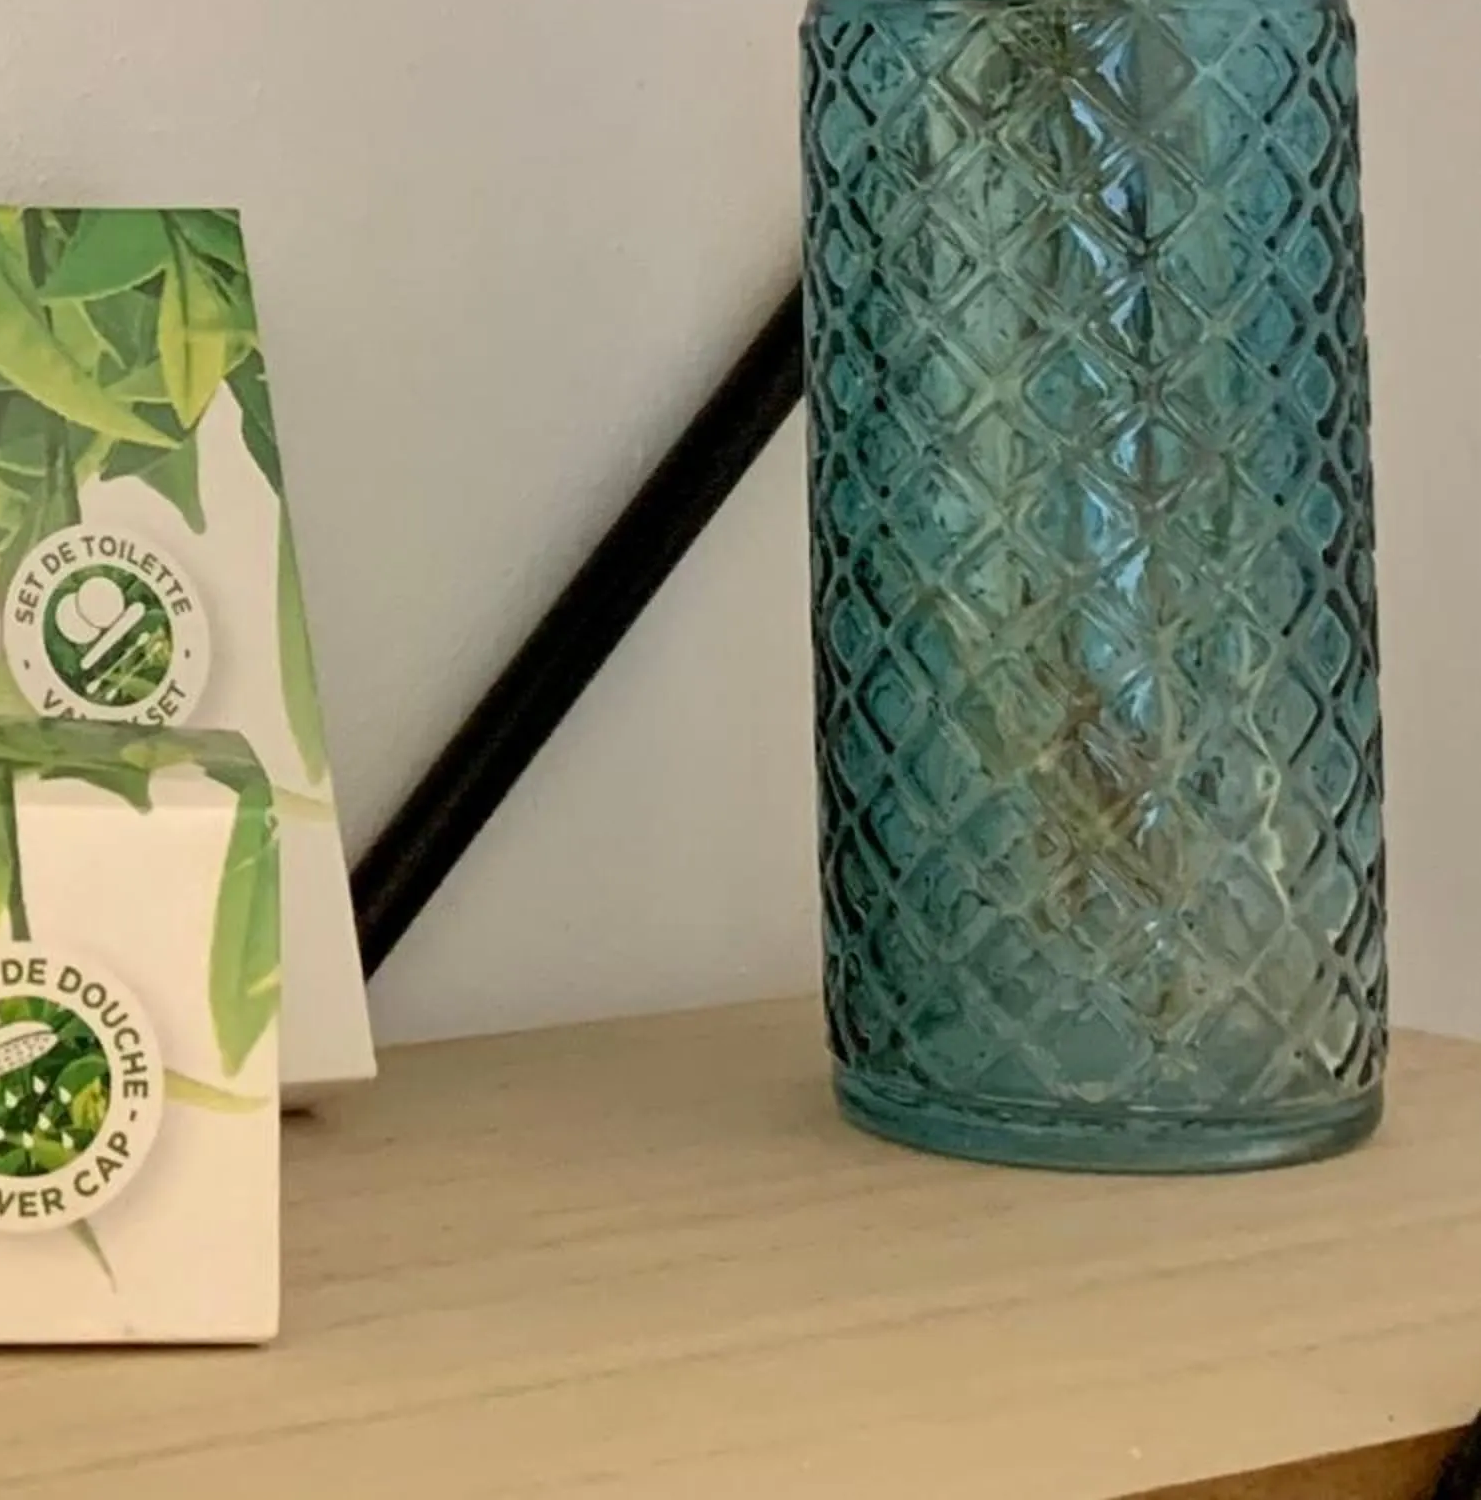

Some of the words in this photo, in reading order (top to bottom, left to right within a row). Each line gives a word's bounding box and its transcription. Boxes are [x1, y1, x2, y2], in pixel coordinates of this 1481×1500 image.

[15, 572, 45, 625] SET
[40, 542, 77, 575] DE
[80, 536, 193, 616] TOILETTE
[145, 679, 186, 725] SET
[0, 958, 48, 986] DE
[57, 966, 149, 1099] DOUCHE
[73, 1131, 133, 1198] CAP
